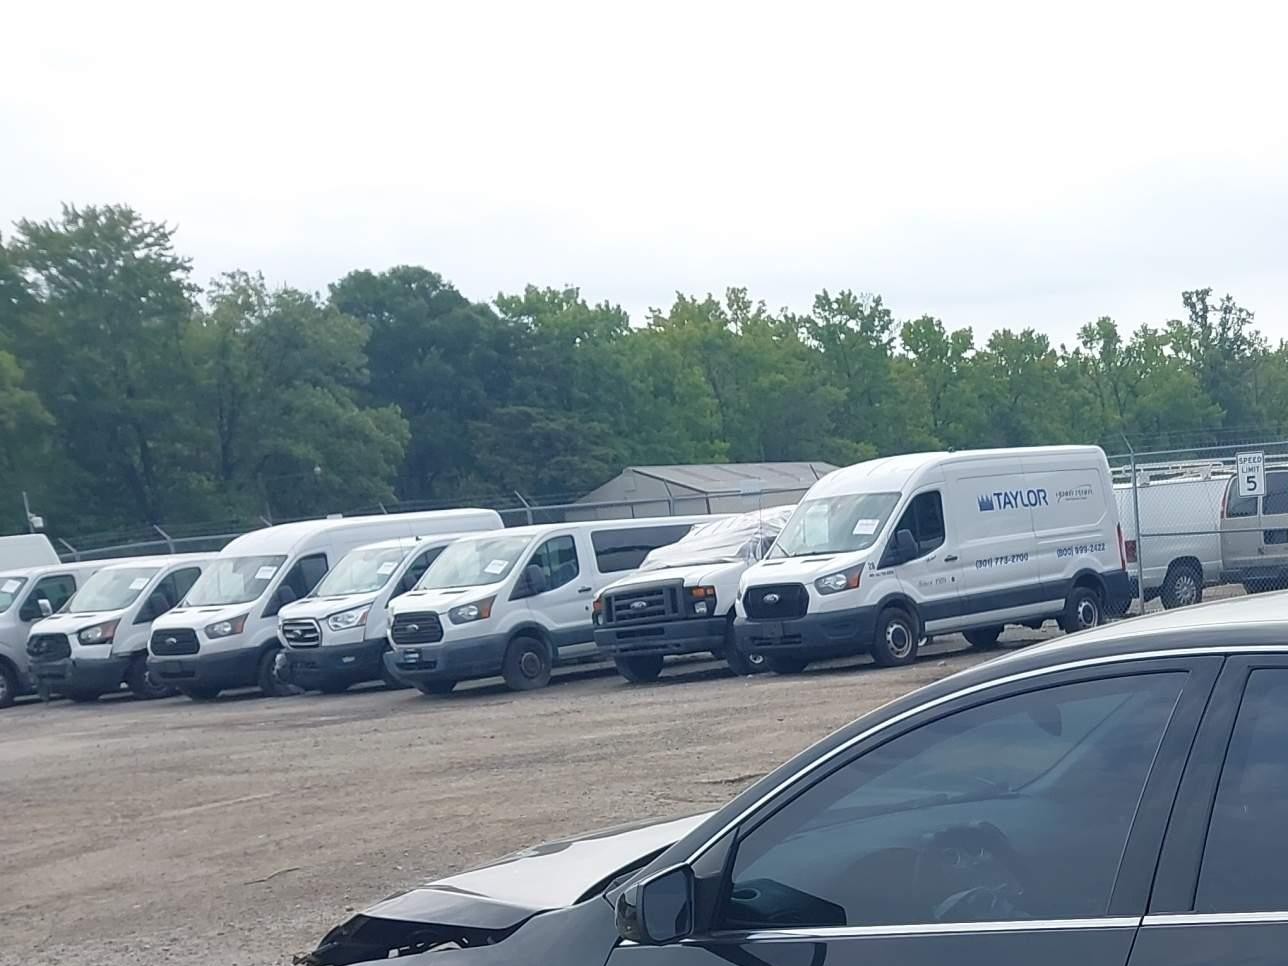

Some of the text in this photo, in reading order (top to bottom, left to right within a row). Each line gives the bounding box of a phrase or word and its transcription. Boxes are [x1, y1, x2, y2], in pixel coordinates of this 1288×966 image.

[1239, 456, 1262, 464] SPEED
[1246, 476, 1257, 491] 5
[993, 488, 1049, 509] TAYLOR
